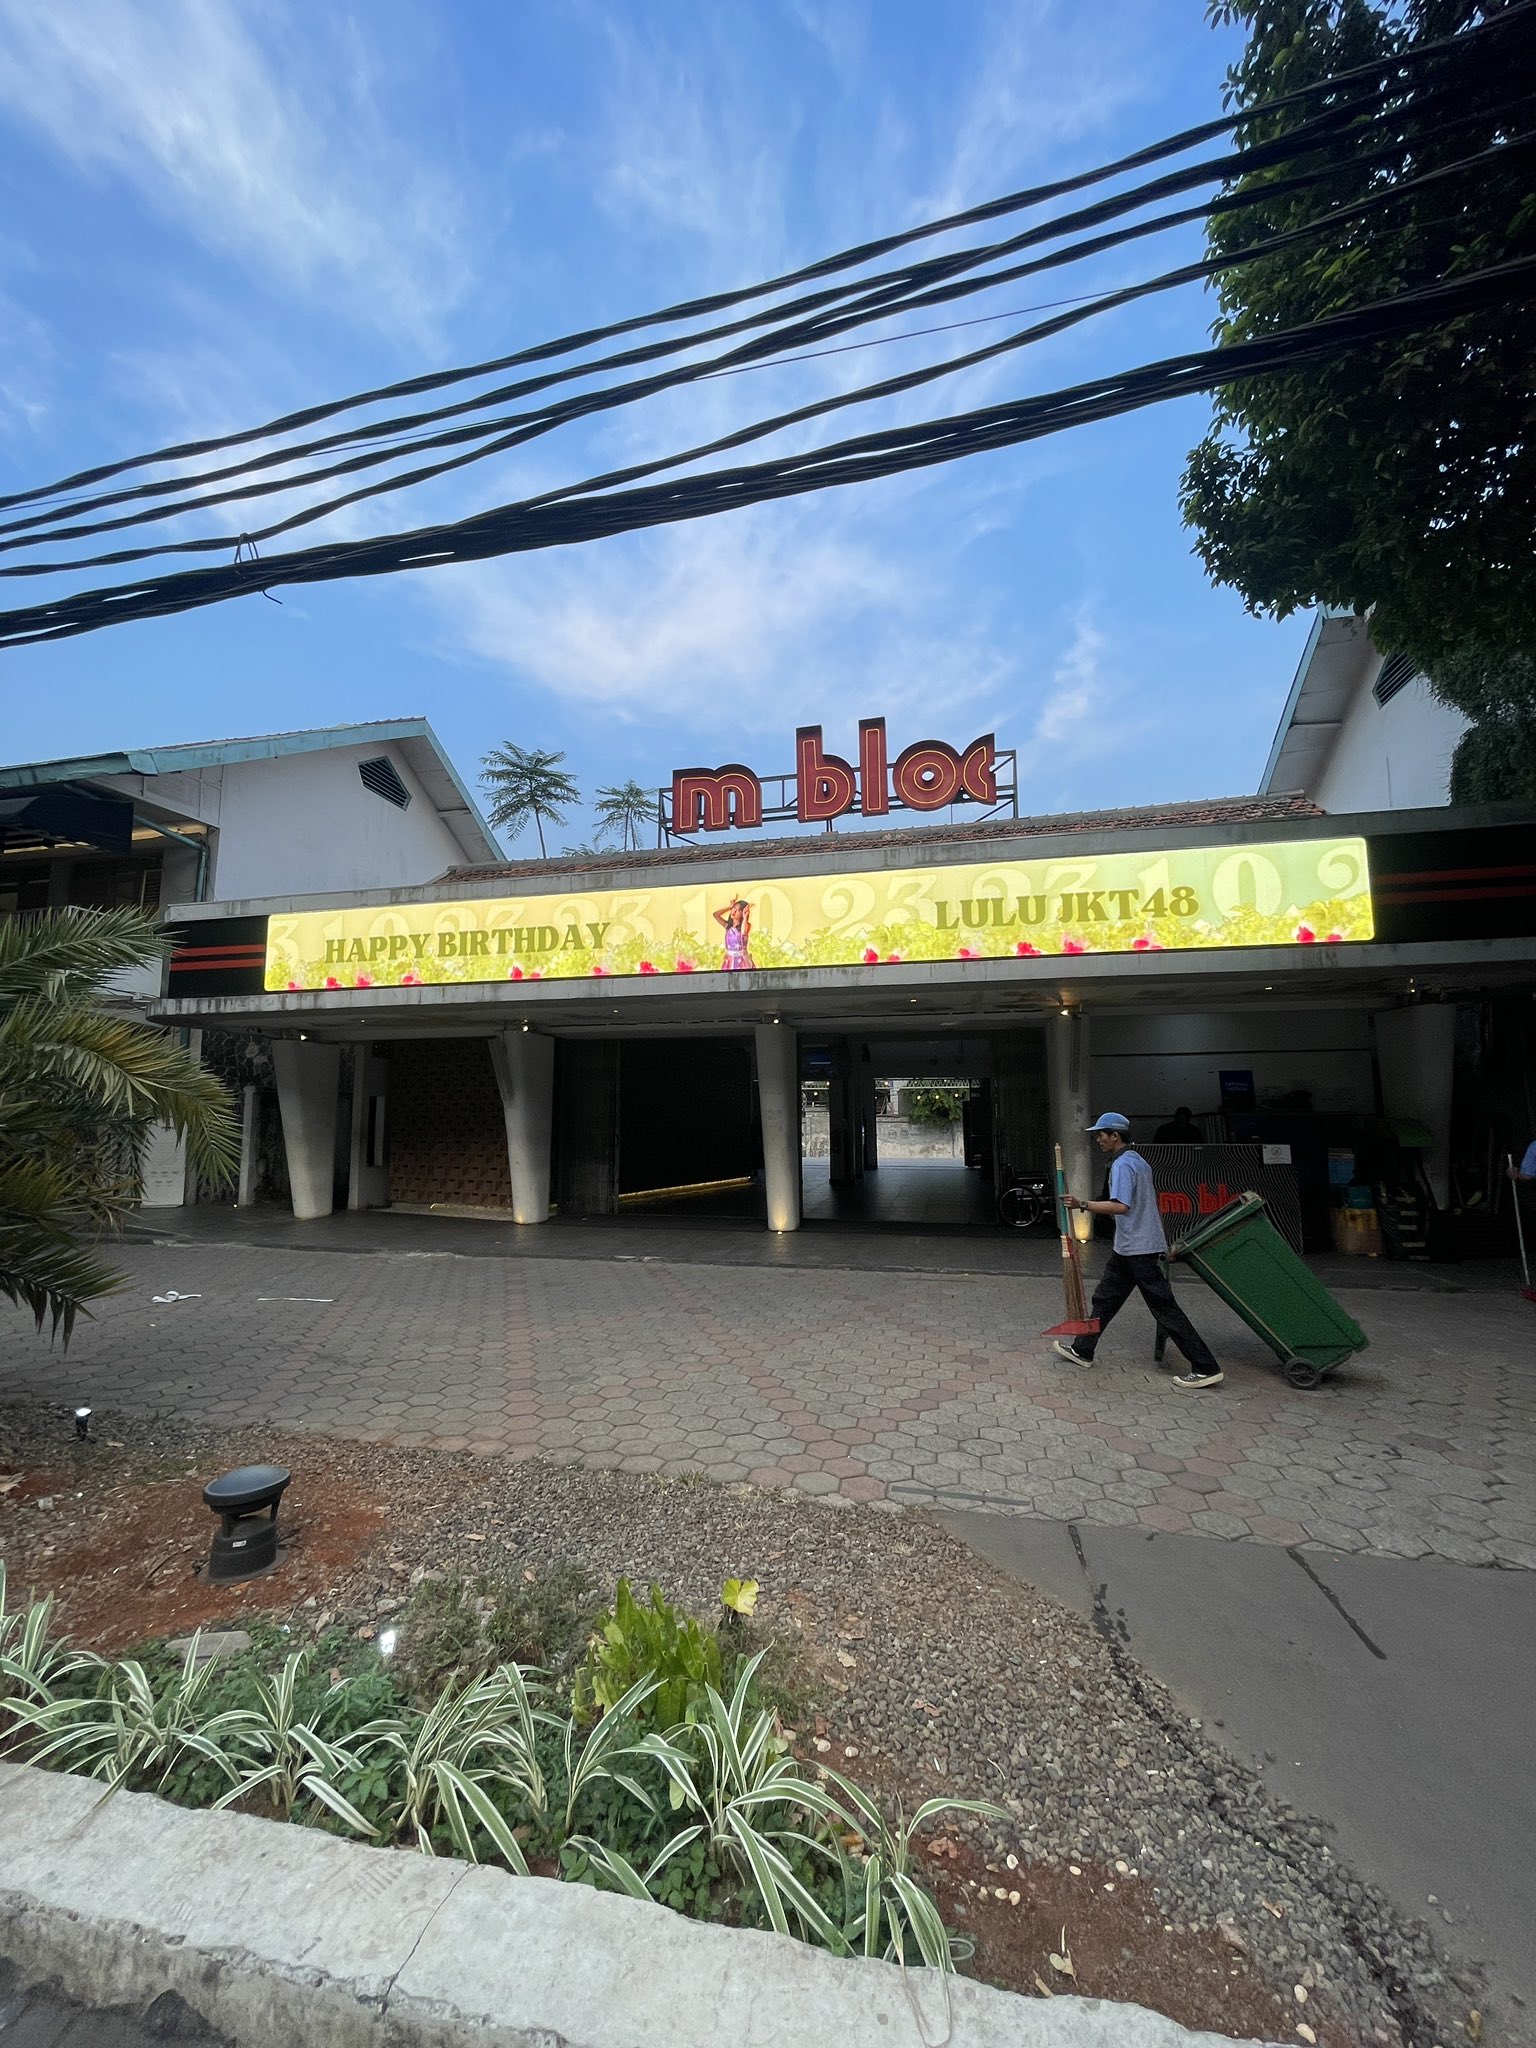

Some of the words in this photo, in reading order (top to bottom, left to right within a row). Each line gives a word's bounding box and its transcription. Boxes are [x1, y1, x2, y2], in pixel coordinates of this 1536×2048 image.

[672, 764, 763, 834] m
[795, 716, 997, 823] bloc
[935, 893, 1048, 931] LULU
[1058, 885, 1200, 923] JKT48
[324, 932, 431, 965] HAPPY
[436, 921, 611, 958] BIRTHDAY
[1158, 1191, 1192, 1214] m
